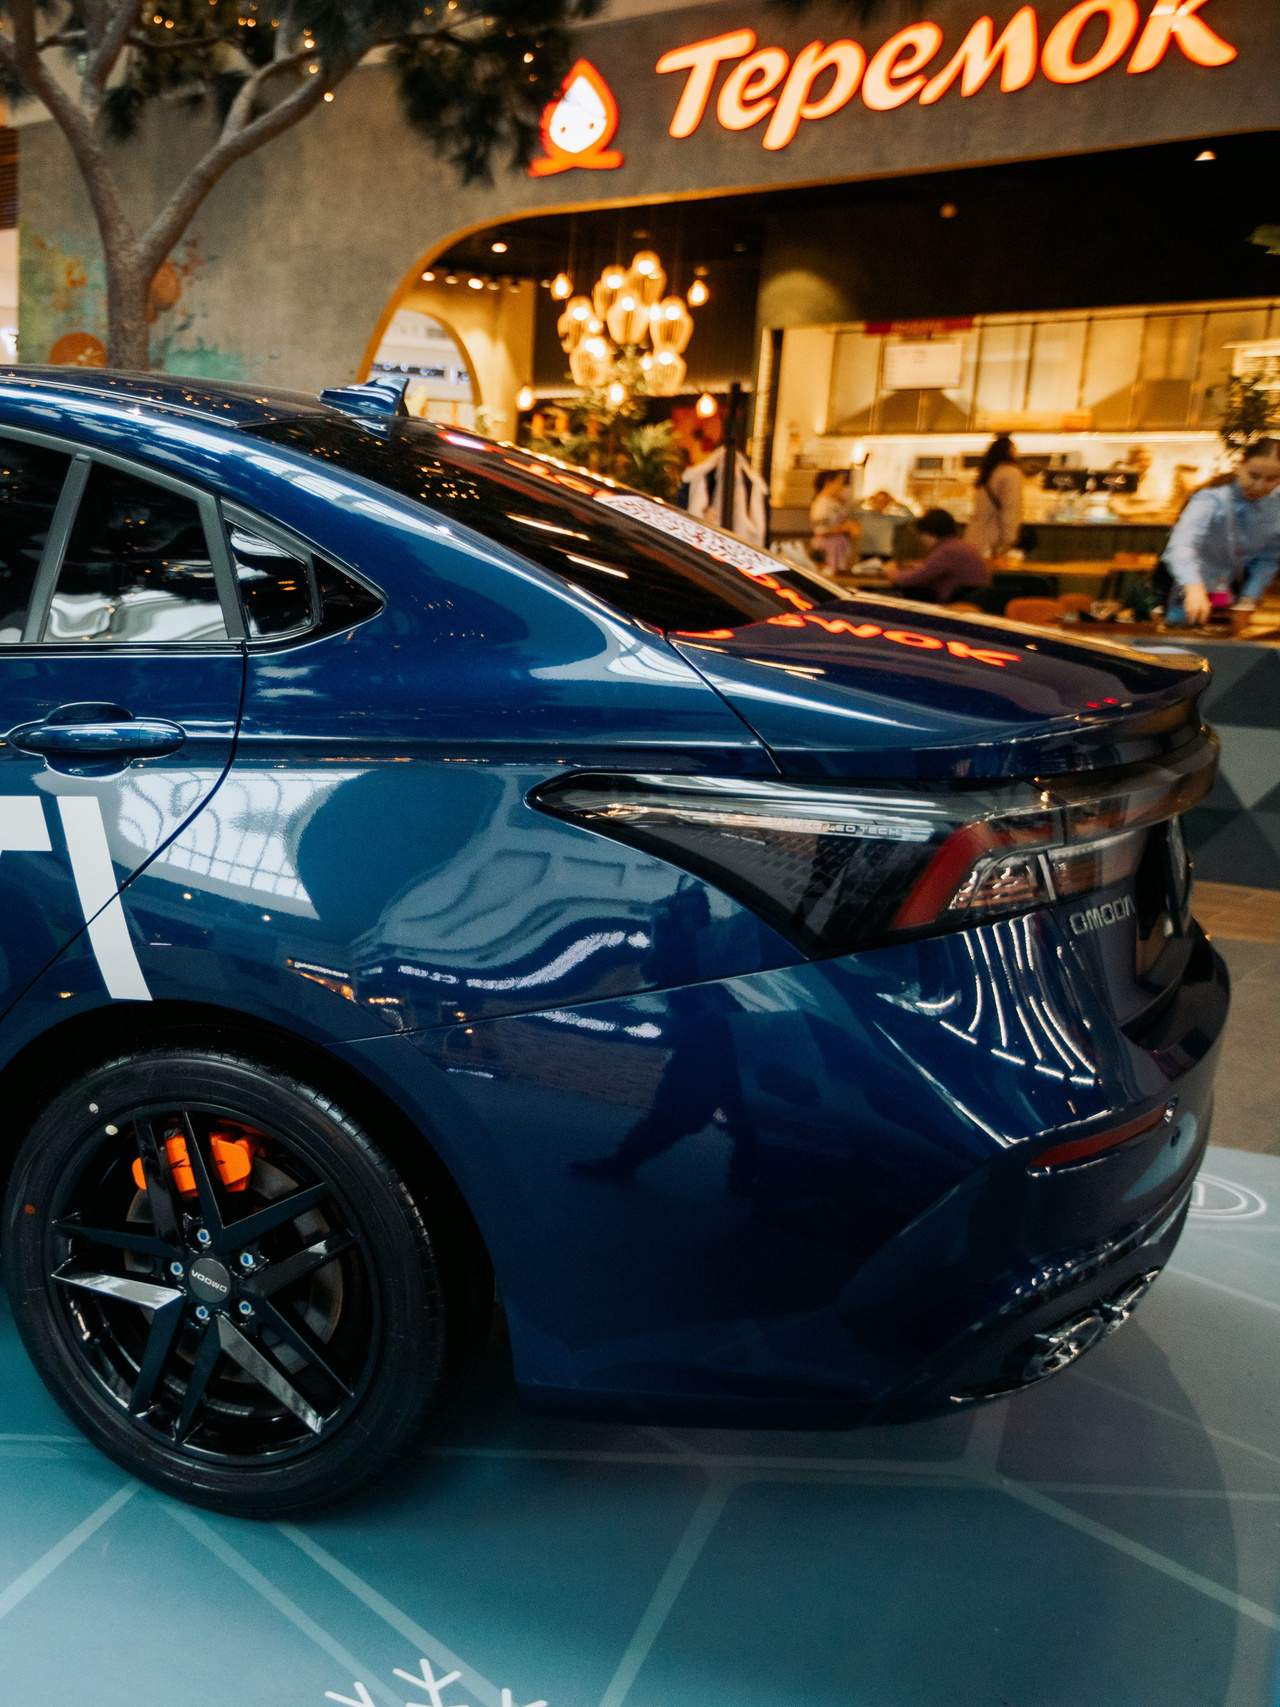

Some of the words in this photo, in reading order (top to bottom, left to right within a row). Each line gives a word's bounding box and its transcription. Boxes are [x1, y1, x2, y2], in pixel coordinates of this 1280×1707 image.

[655, 0, 1238, 151] Теремок
[860, 826, 900, 836] TECH
[1069, 895, 1136, 936] OMODA
[191, 1269, 228, 1293] OMODA
